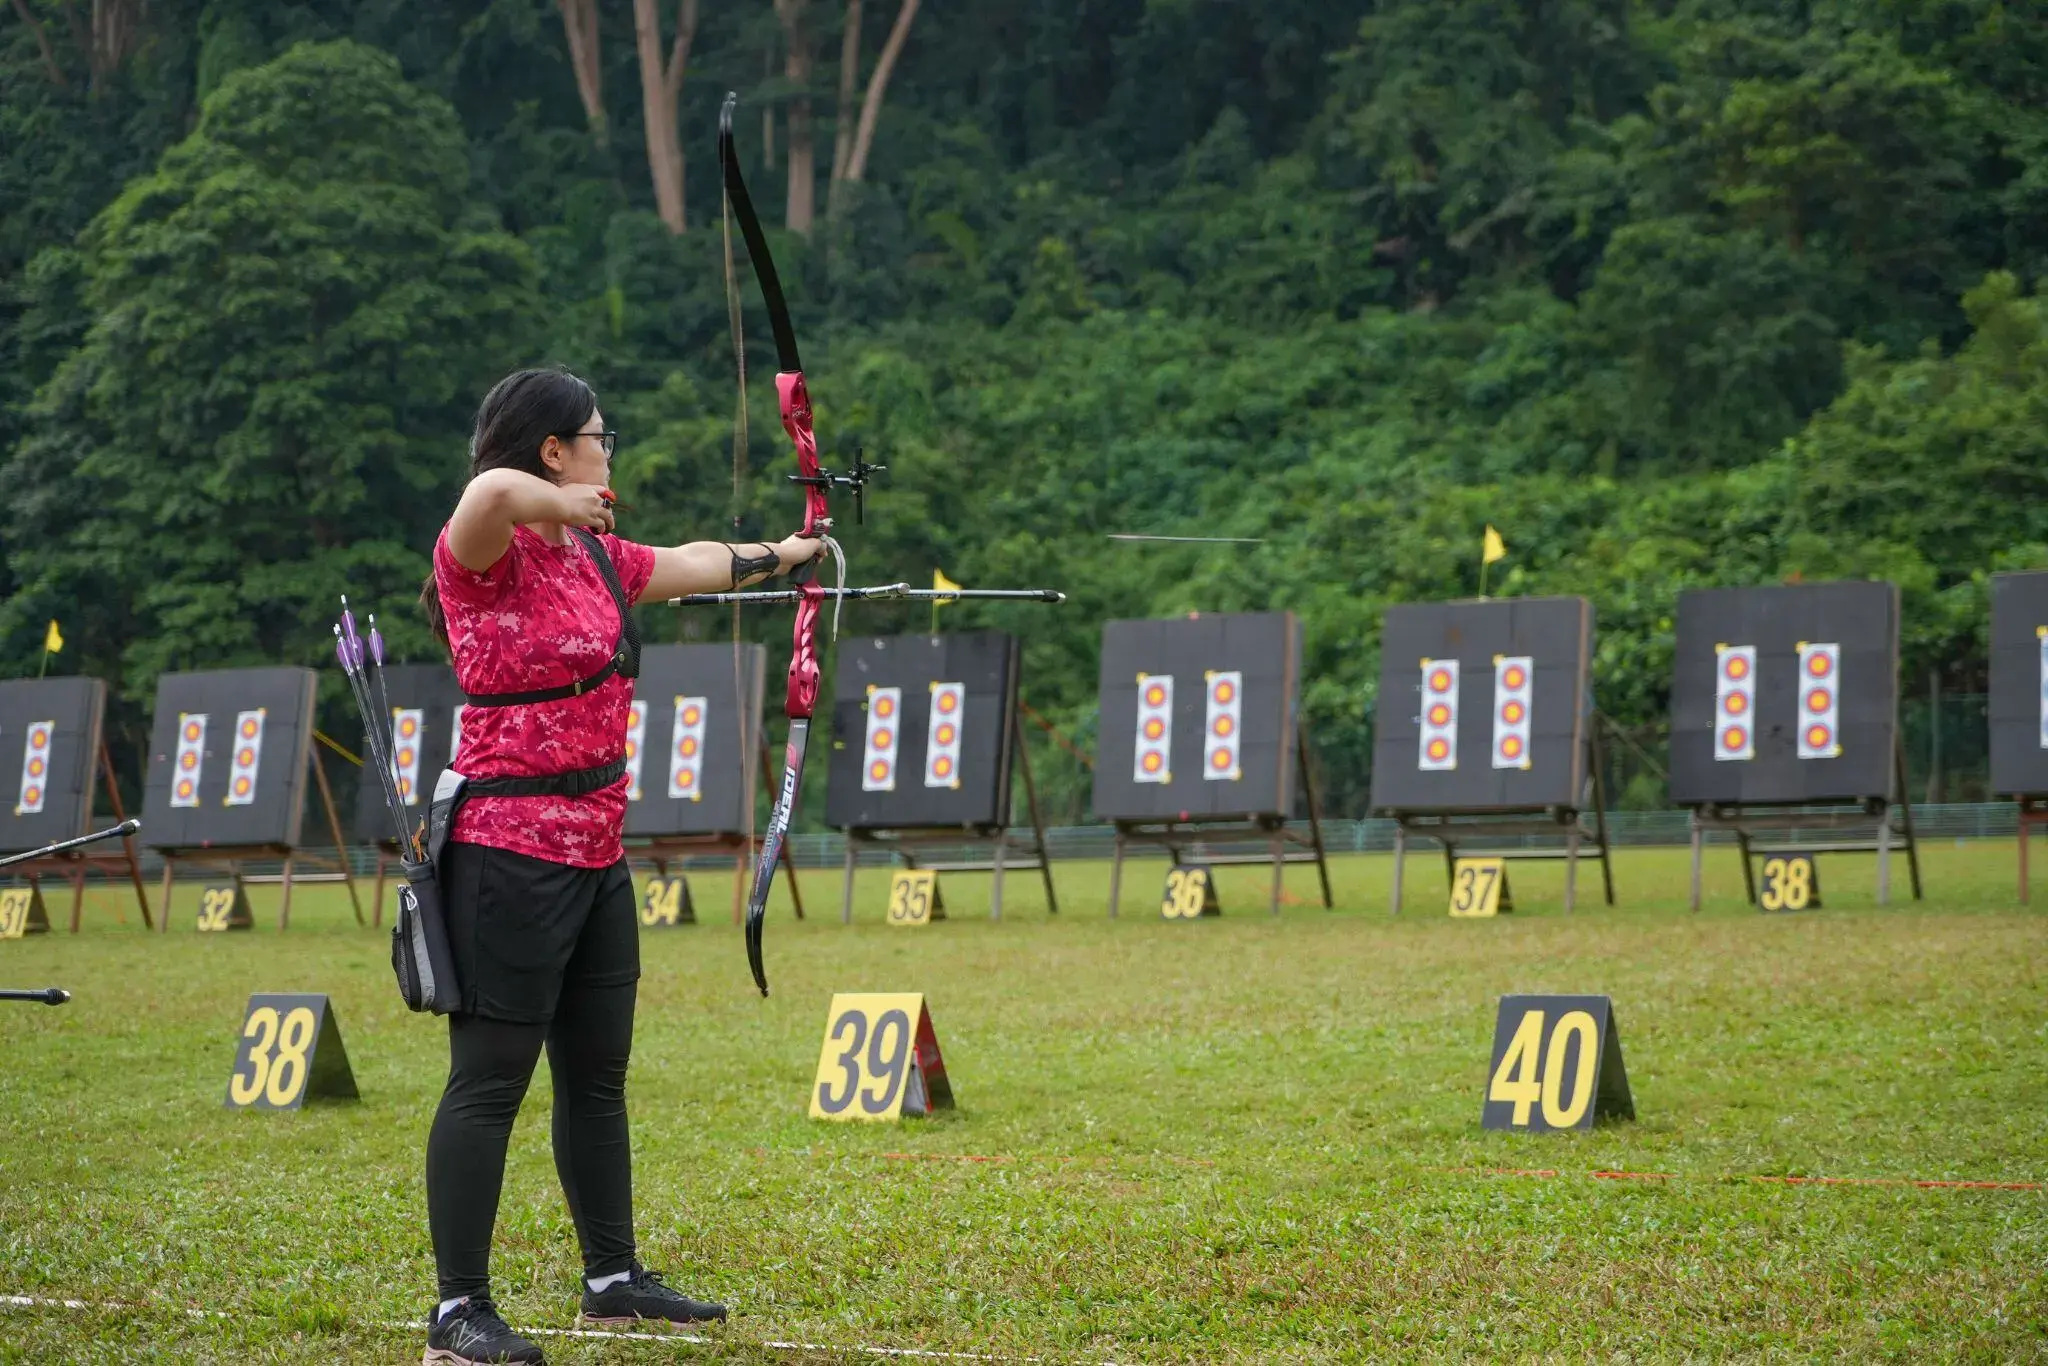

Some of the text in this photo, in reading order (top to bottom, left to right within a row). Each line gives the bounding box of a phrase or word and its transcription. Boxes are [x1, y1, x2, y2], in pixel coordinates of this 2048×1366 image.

[777, 766, 796, 833] IDEAL
[641, 879, 683, 925] 34
[893, 880, 929, 919] 35
[1162, 870, 1206, 918] 36
[1456, 868, 1497, 910] 37
[1762, 857, 1810, 910] 38
[0, 896, 27, 931] 31
[198, 889, 235, 931] 32
[231, 1006, 315, 1106] 38
[819, 1008, 909, 1114] 39
[1489, 1010, 1598, 1128] 40
